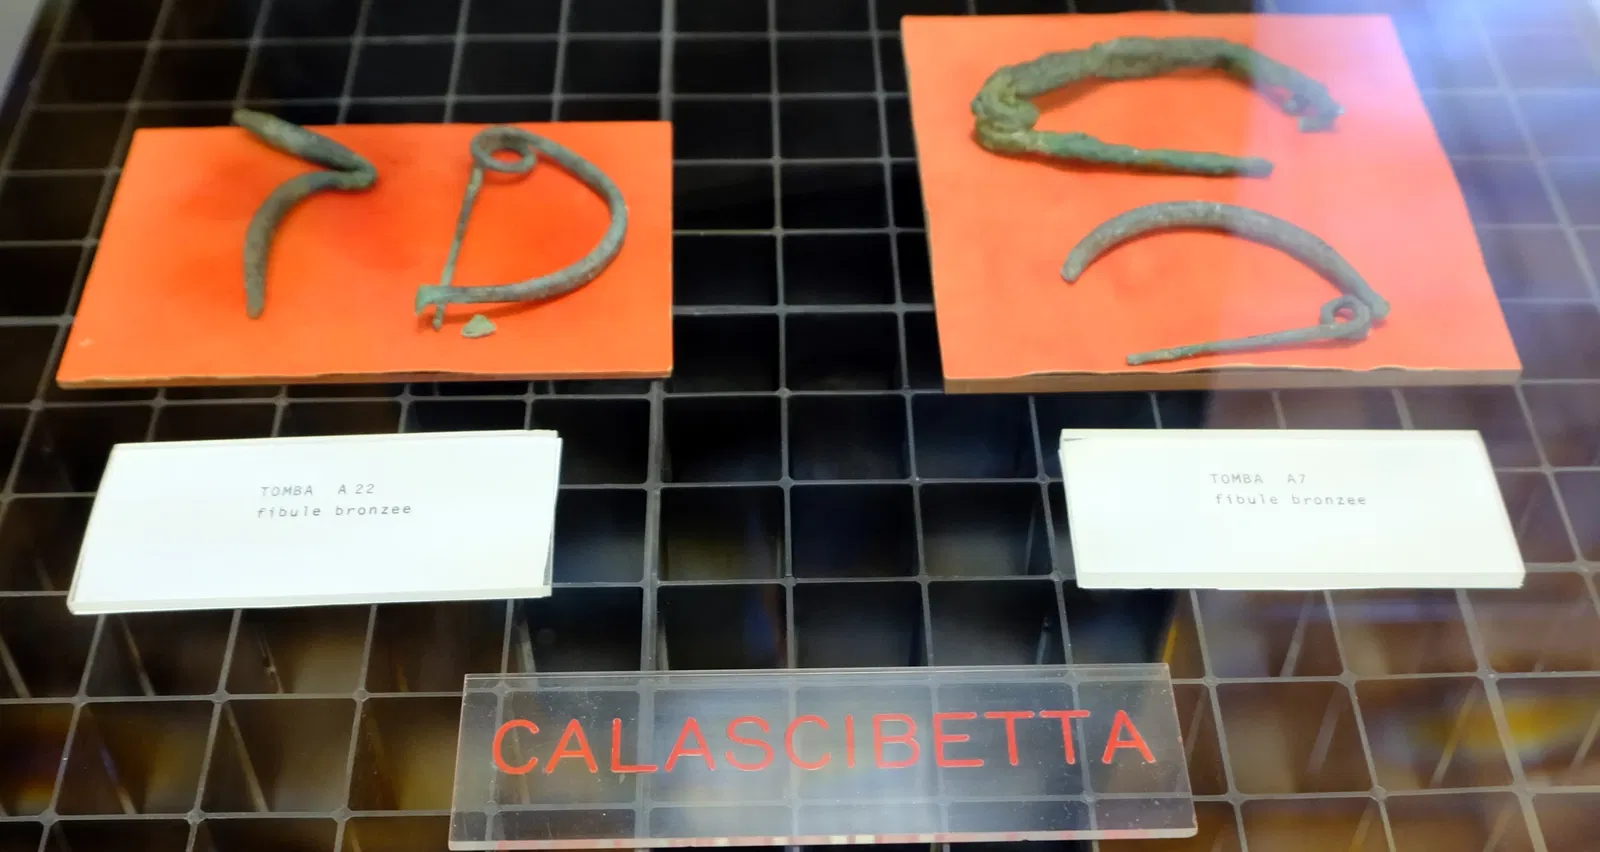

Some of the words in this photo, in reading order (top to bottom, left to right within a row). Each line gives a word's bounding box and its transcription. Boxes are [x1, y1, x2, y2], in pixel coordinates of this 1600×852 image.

[1209, 473, 1264, 484] TOMBA
[1287, 473, 1306, 484] A7
[260, 485, 314, 497] TOMBA
[1215, 493, 1279, 505] fibule
[1291, 494, 1367, 506] bronzee
[257, 505, 321, 518] fibule
[335, 504, 412, 516] bronzee
[491, 709, 1157, 775] CALASCIBETTA
